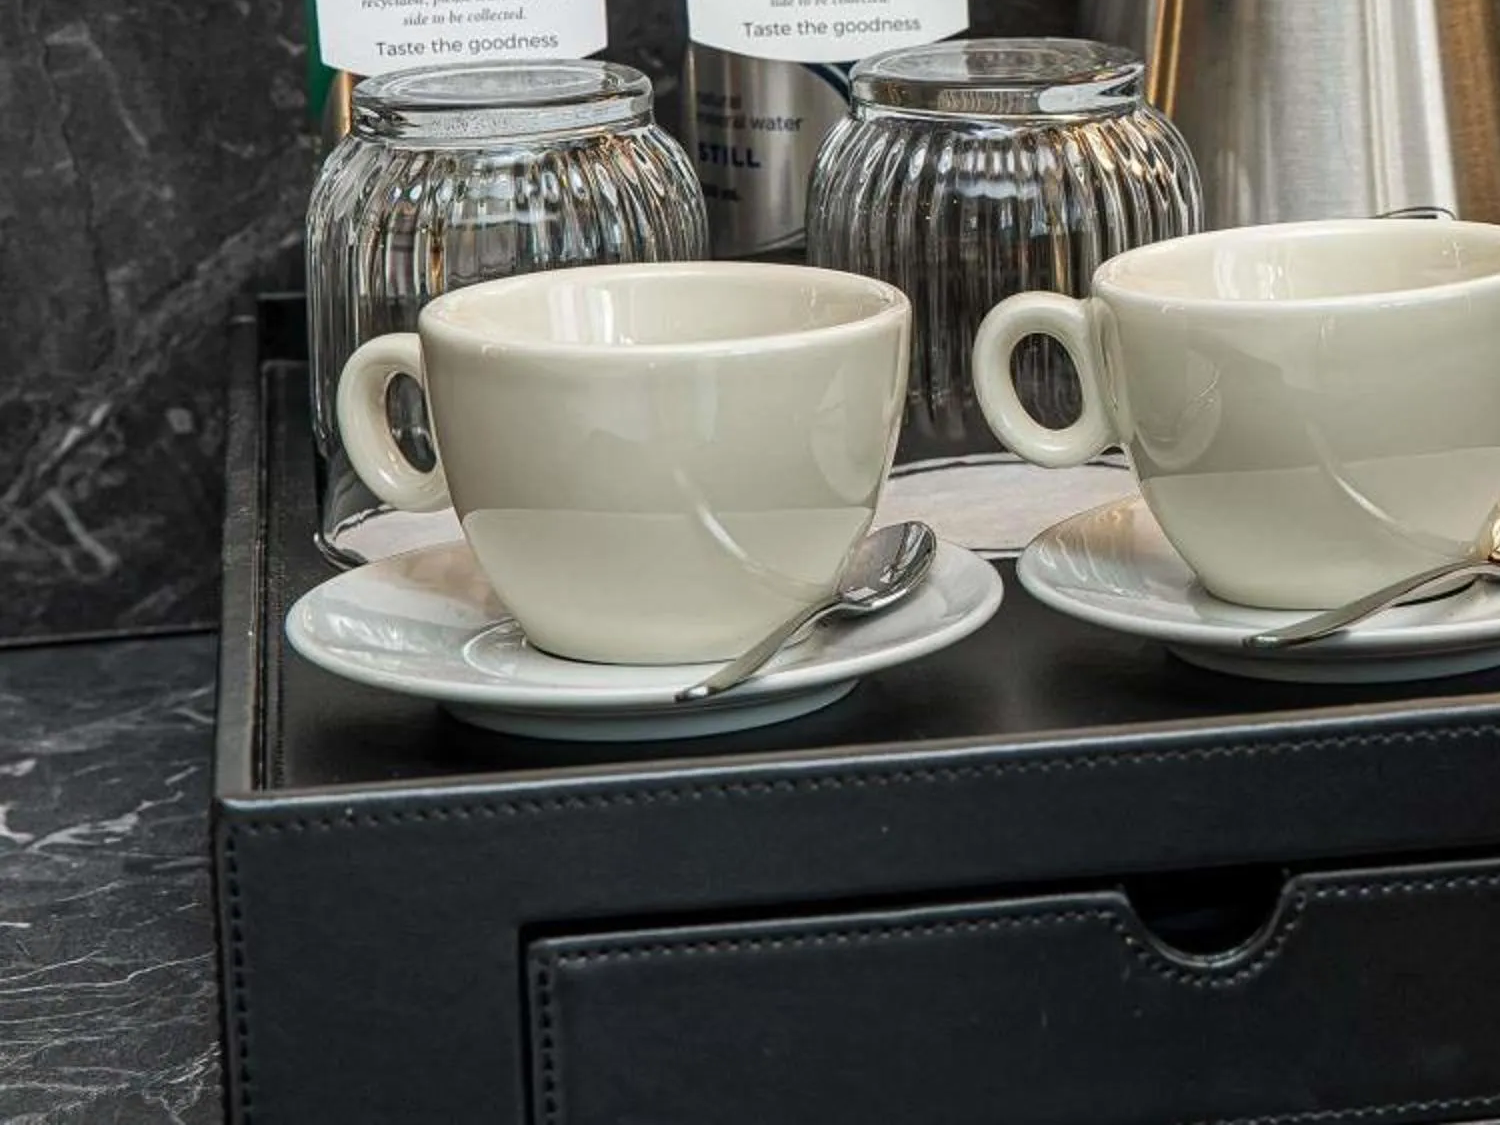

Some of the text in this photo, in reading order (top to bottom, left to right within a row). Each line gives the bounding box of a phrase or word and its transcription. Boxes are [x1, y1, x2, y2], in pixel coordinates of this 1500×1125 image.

[403, 12, 427, 26] side
[449, 10, 463, 23] be
[743, 16, 921, 38] Taste the goodness
[376, 33, 558, 57] Taste the goodness
[752, 116, 803, 131] water
[698, 143, 761, 168] STILL
